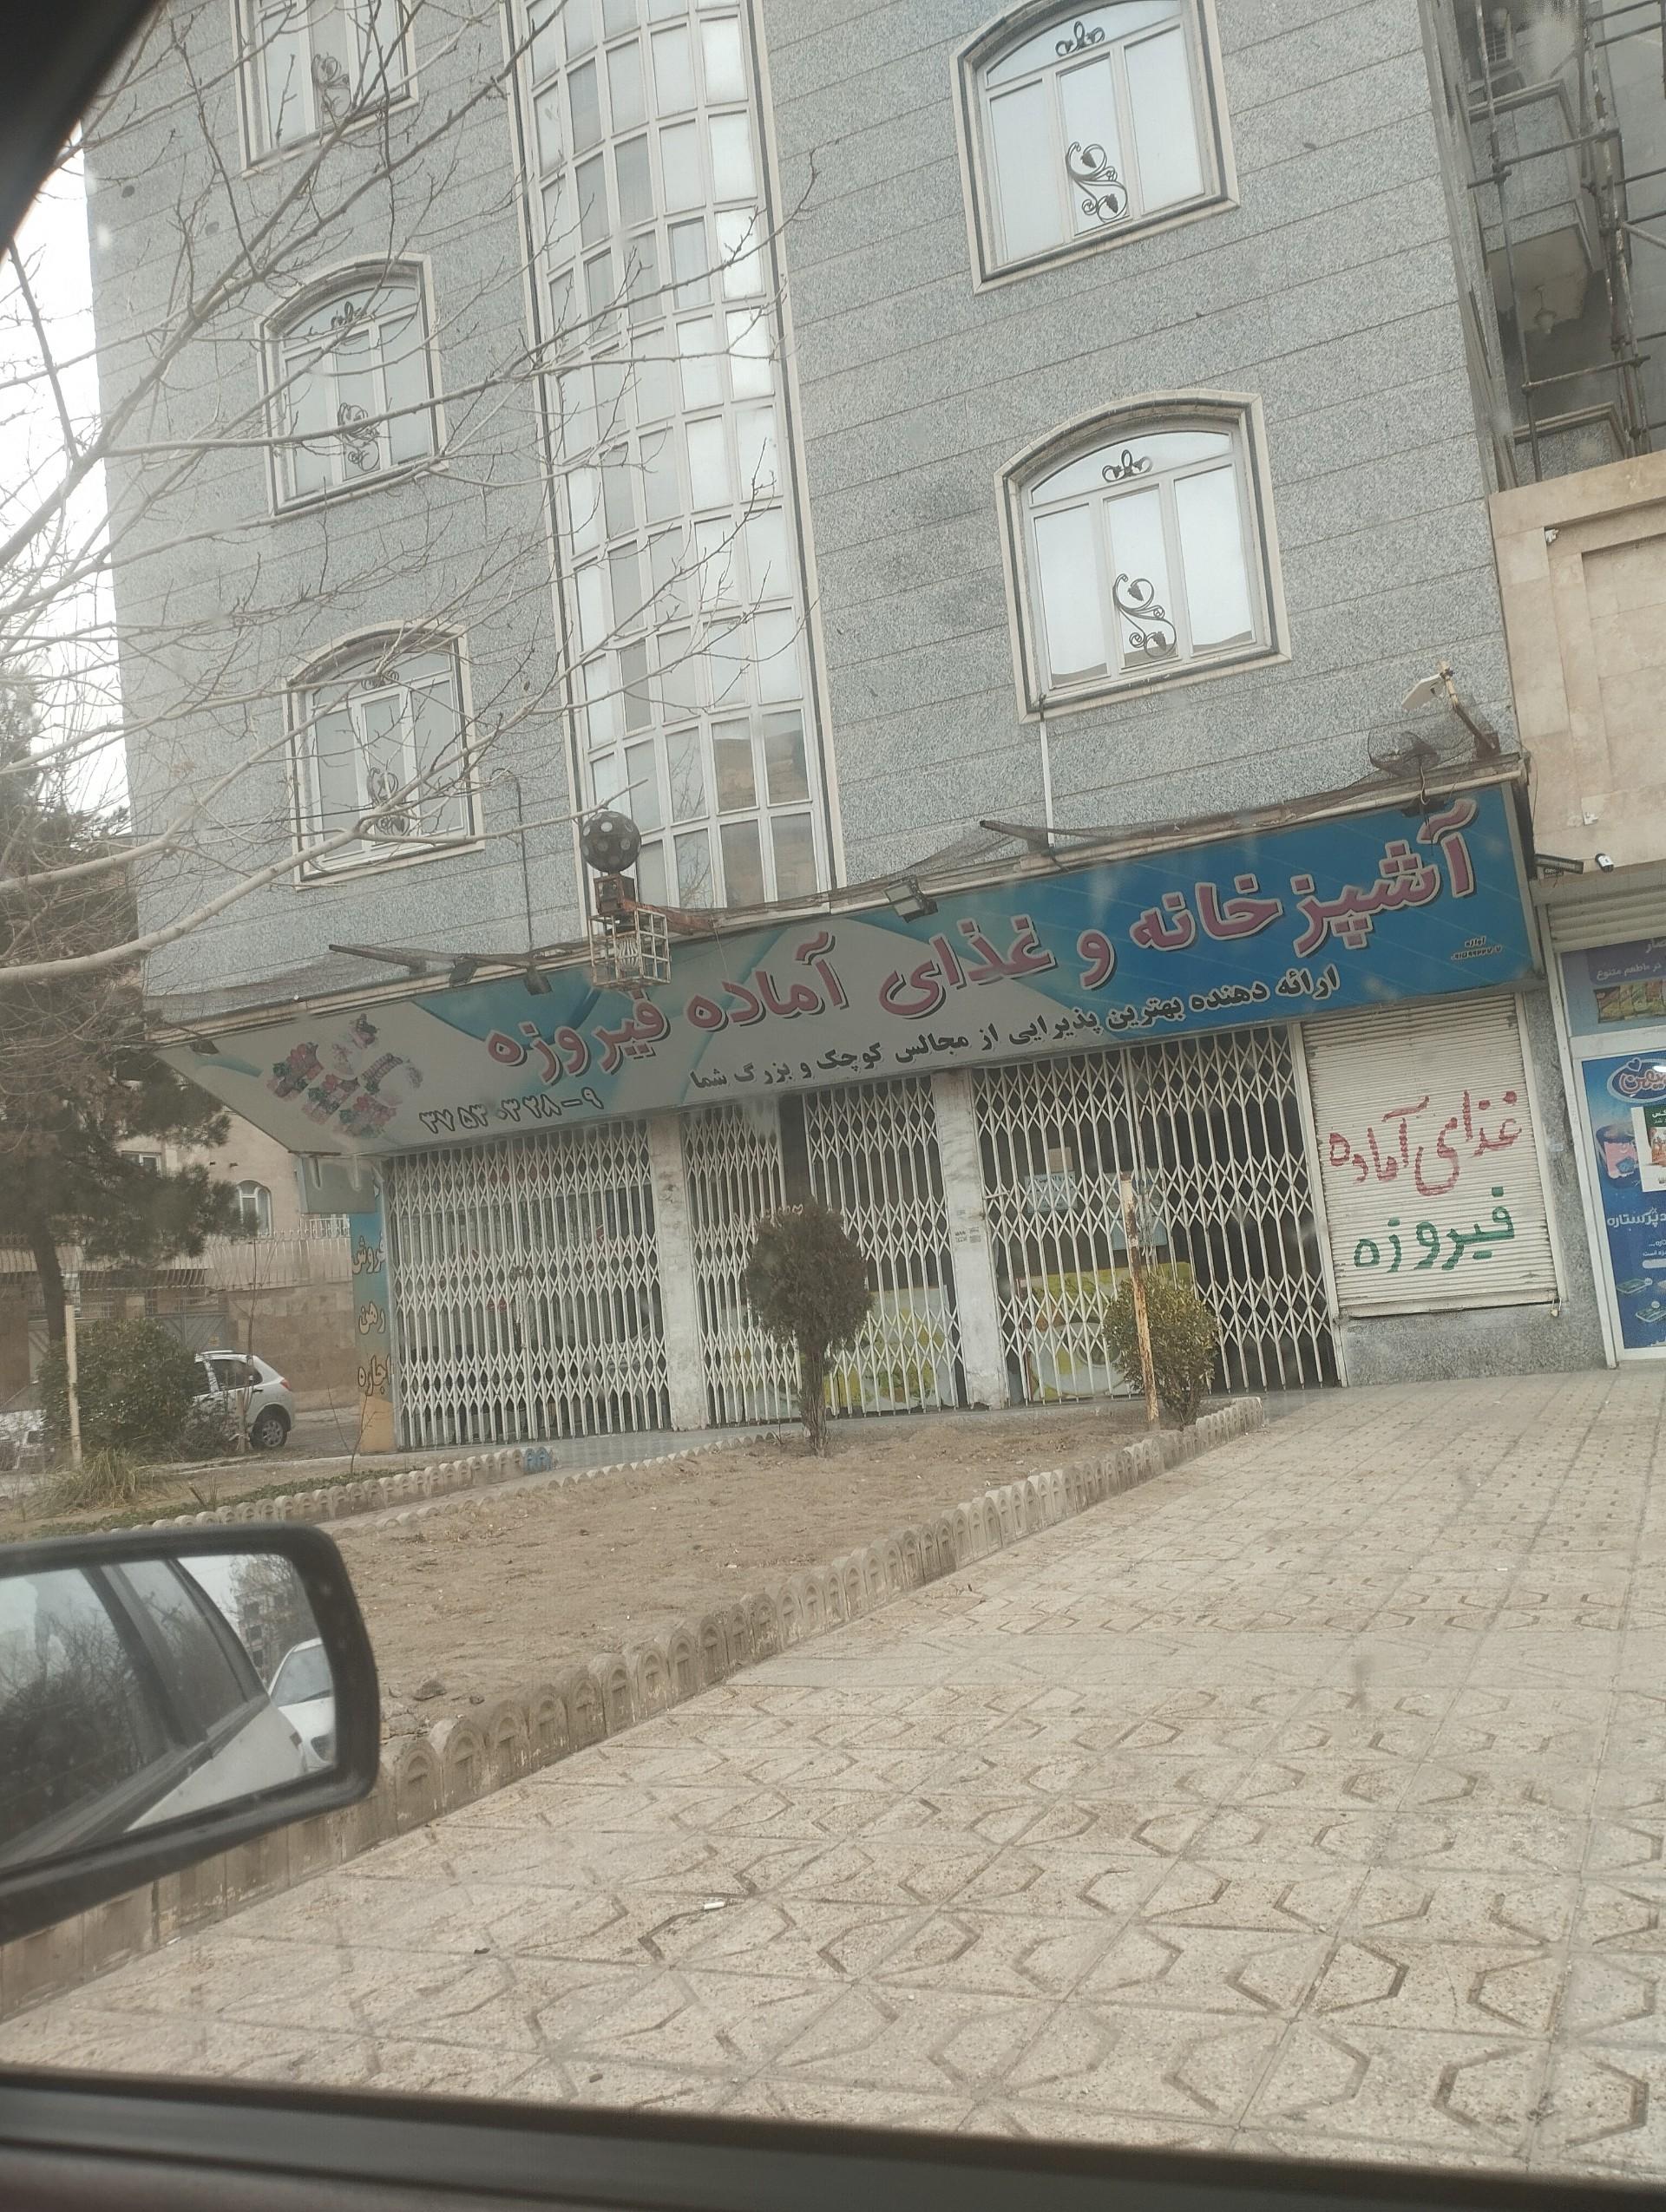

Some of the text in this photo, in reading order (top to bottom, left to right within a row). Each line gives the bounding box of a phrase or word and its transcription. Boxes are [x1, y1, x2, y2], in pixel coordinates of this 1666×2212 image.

[487, 798, 1477, 1084] آشپزخانه و غذای آماده فیروزه
[1597, 967, 1621, 981] متنوع
[690, 964, 1340, 1089] ارائه دهنده بهترین پذیرایی از مجالس کوچک و بزرگ شما
[1328, 1090, 1523, 1196] غذای آماده
[351, 1233, 387, 1274] فروش
[1354, 1187, 1516, 1273] فیروزه
[358, 1301, 385, 1335] رهن
[357, 1355, 391, 1396] اجاره
